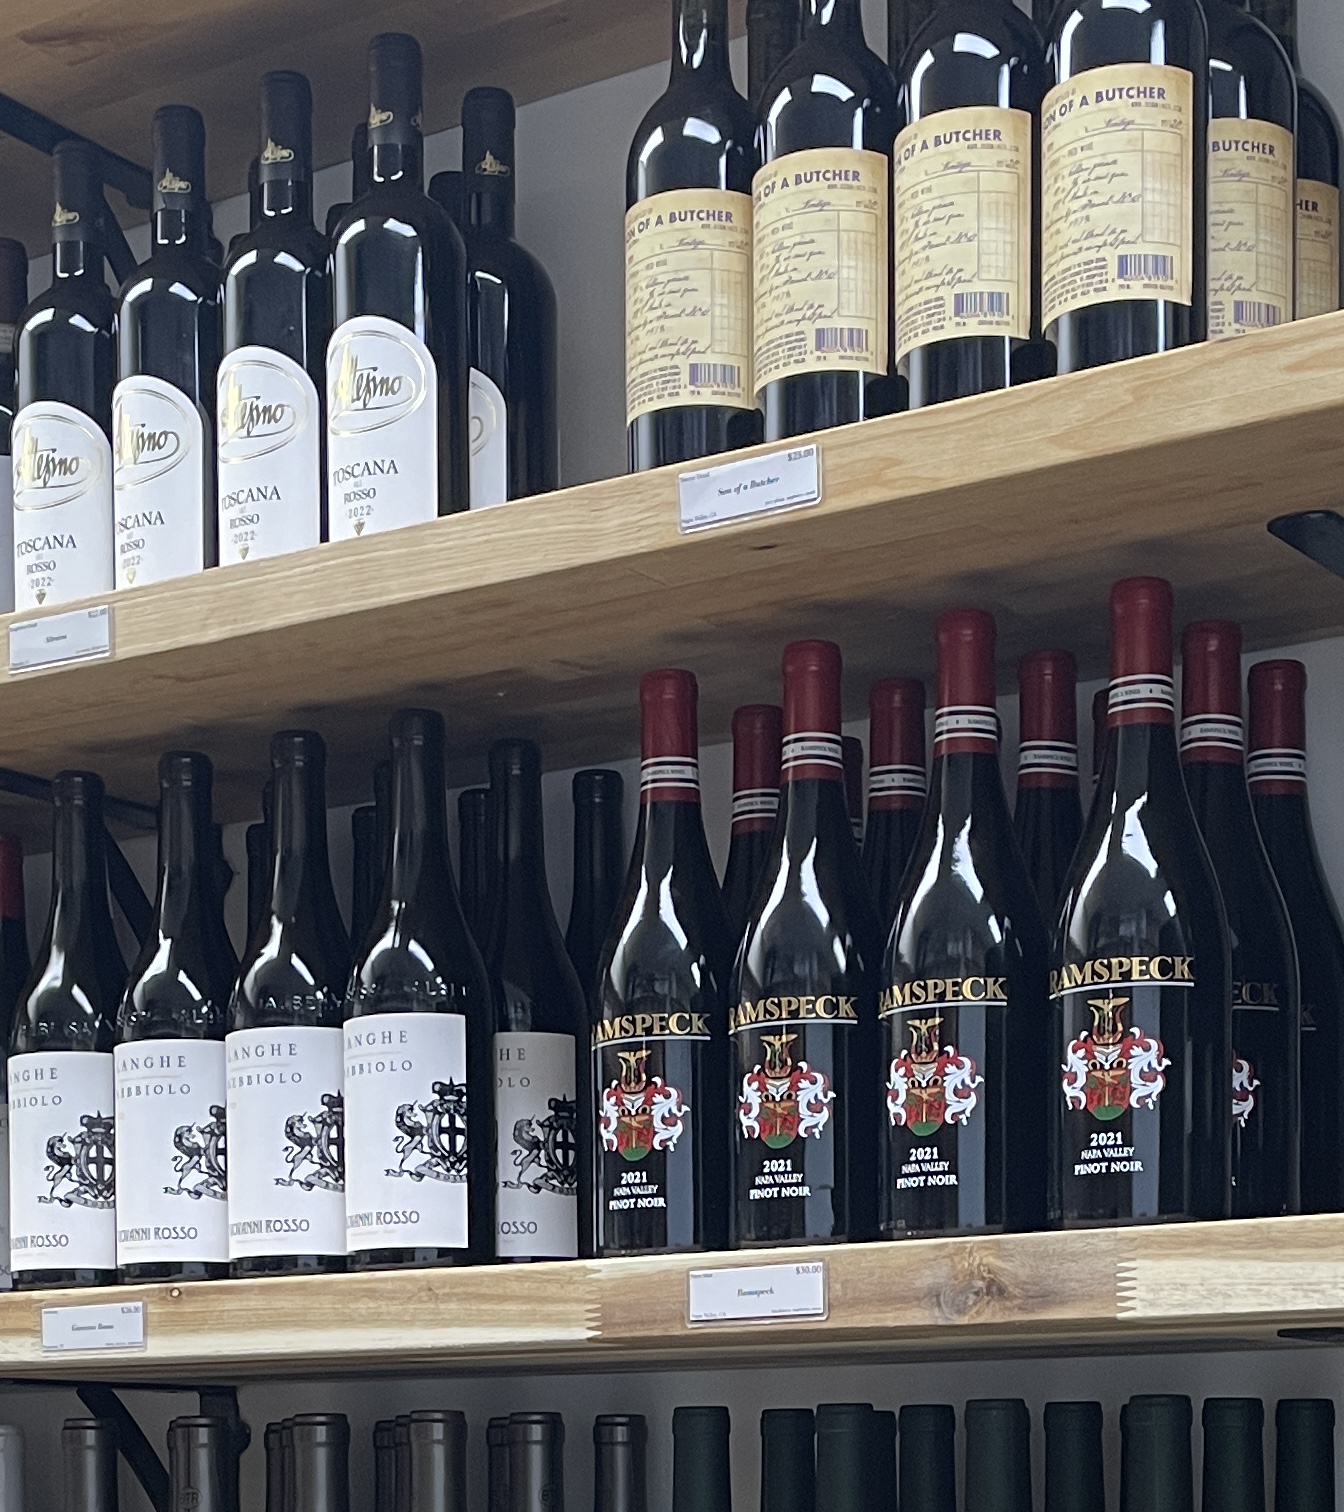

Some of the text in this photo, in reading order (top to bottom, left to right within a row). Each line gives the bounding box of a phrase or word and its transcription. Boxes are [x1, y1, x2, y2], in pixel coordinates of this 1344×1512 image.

[1059, 102, 1074, 116] OF
[1079, 96, 1088, 107] A
[1096, 87, 1166, 104] BUTCHER
[1212, 141, 1275, 157] BUTCHER
[637, 221, 651, 235] OF
[655, 211, 664, 224] A
[670, 210, 733, 223] BUTCHER
[333, 459, 399, 486] TOSCANA
[221, 485, 281, 512] TOSCANA
[344, 487, 376, 503] ROSSO
[1050, 956, 1194, 994] RAMSPECK
[729, 996, 857, 1030] RAMSPECK
[1090, 1132, 1122, 1146] 2021
[910, 1148, 938, 1160] 2021
[763, 1160, 792, 1172] 2021
[1074, 1161, 1143, 1175] PINOT NOIR
[621, 1172, 647, 1183] 2021
[897, 1175, 958, 1188] PINOT NOIR
[749, 1186, 811, 1199] PINOT NOIR
[609, 1198, 666, 1210] PINOT NOIR
[265, 1218, 310, 1232] ROSSO
[30, 1234, 69, 1248] ROSSO
[796, 1265, 821, 1274] $30.00
